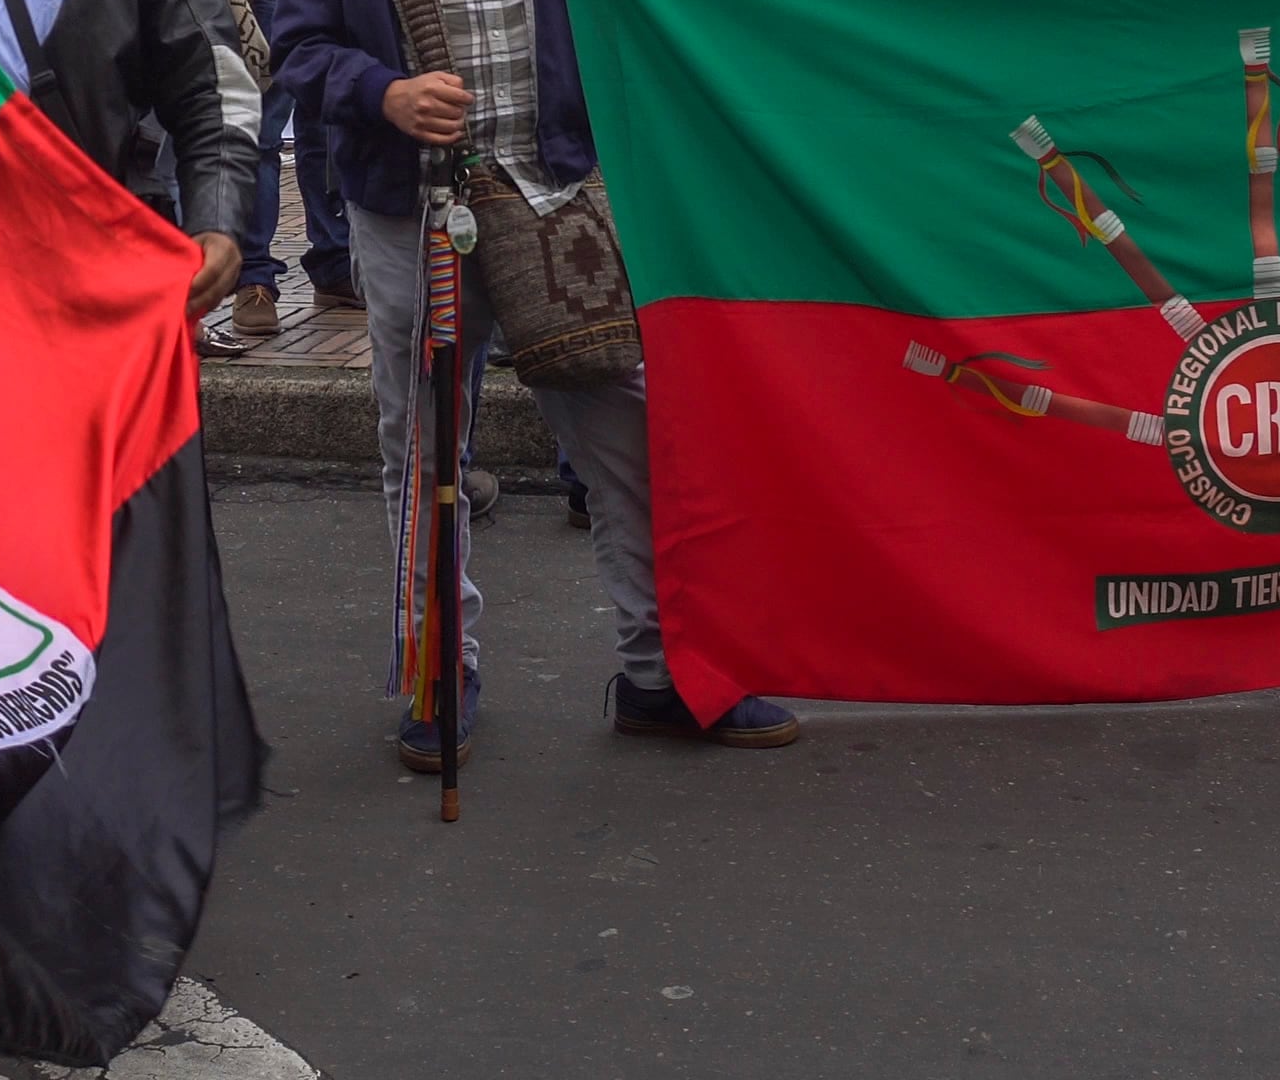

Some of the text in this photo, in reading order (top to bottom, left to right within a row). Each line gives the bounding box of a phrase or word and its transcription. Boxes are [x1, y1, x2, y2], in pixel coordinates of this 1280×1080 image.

[1167, 306, 1268, 415] REGIONAL
[1167, 429, 1252, 526] CONSEJO
[1107, 580, 1220, 619] UNIDAD
